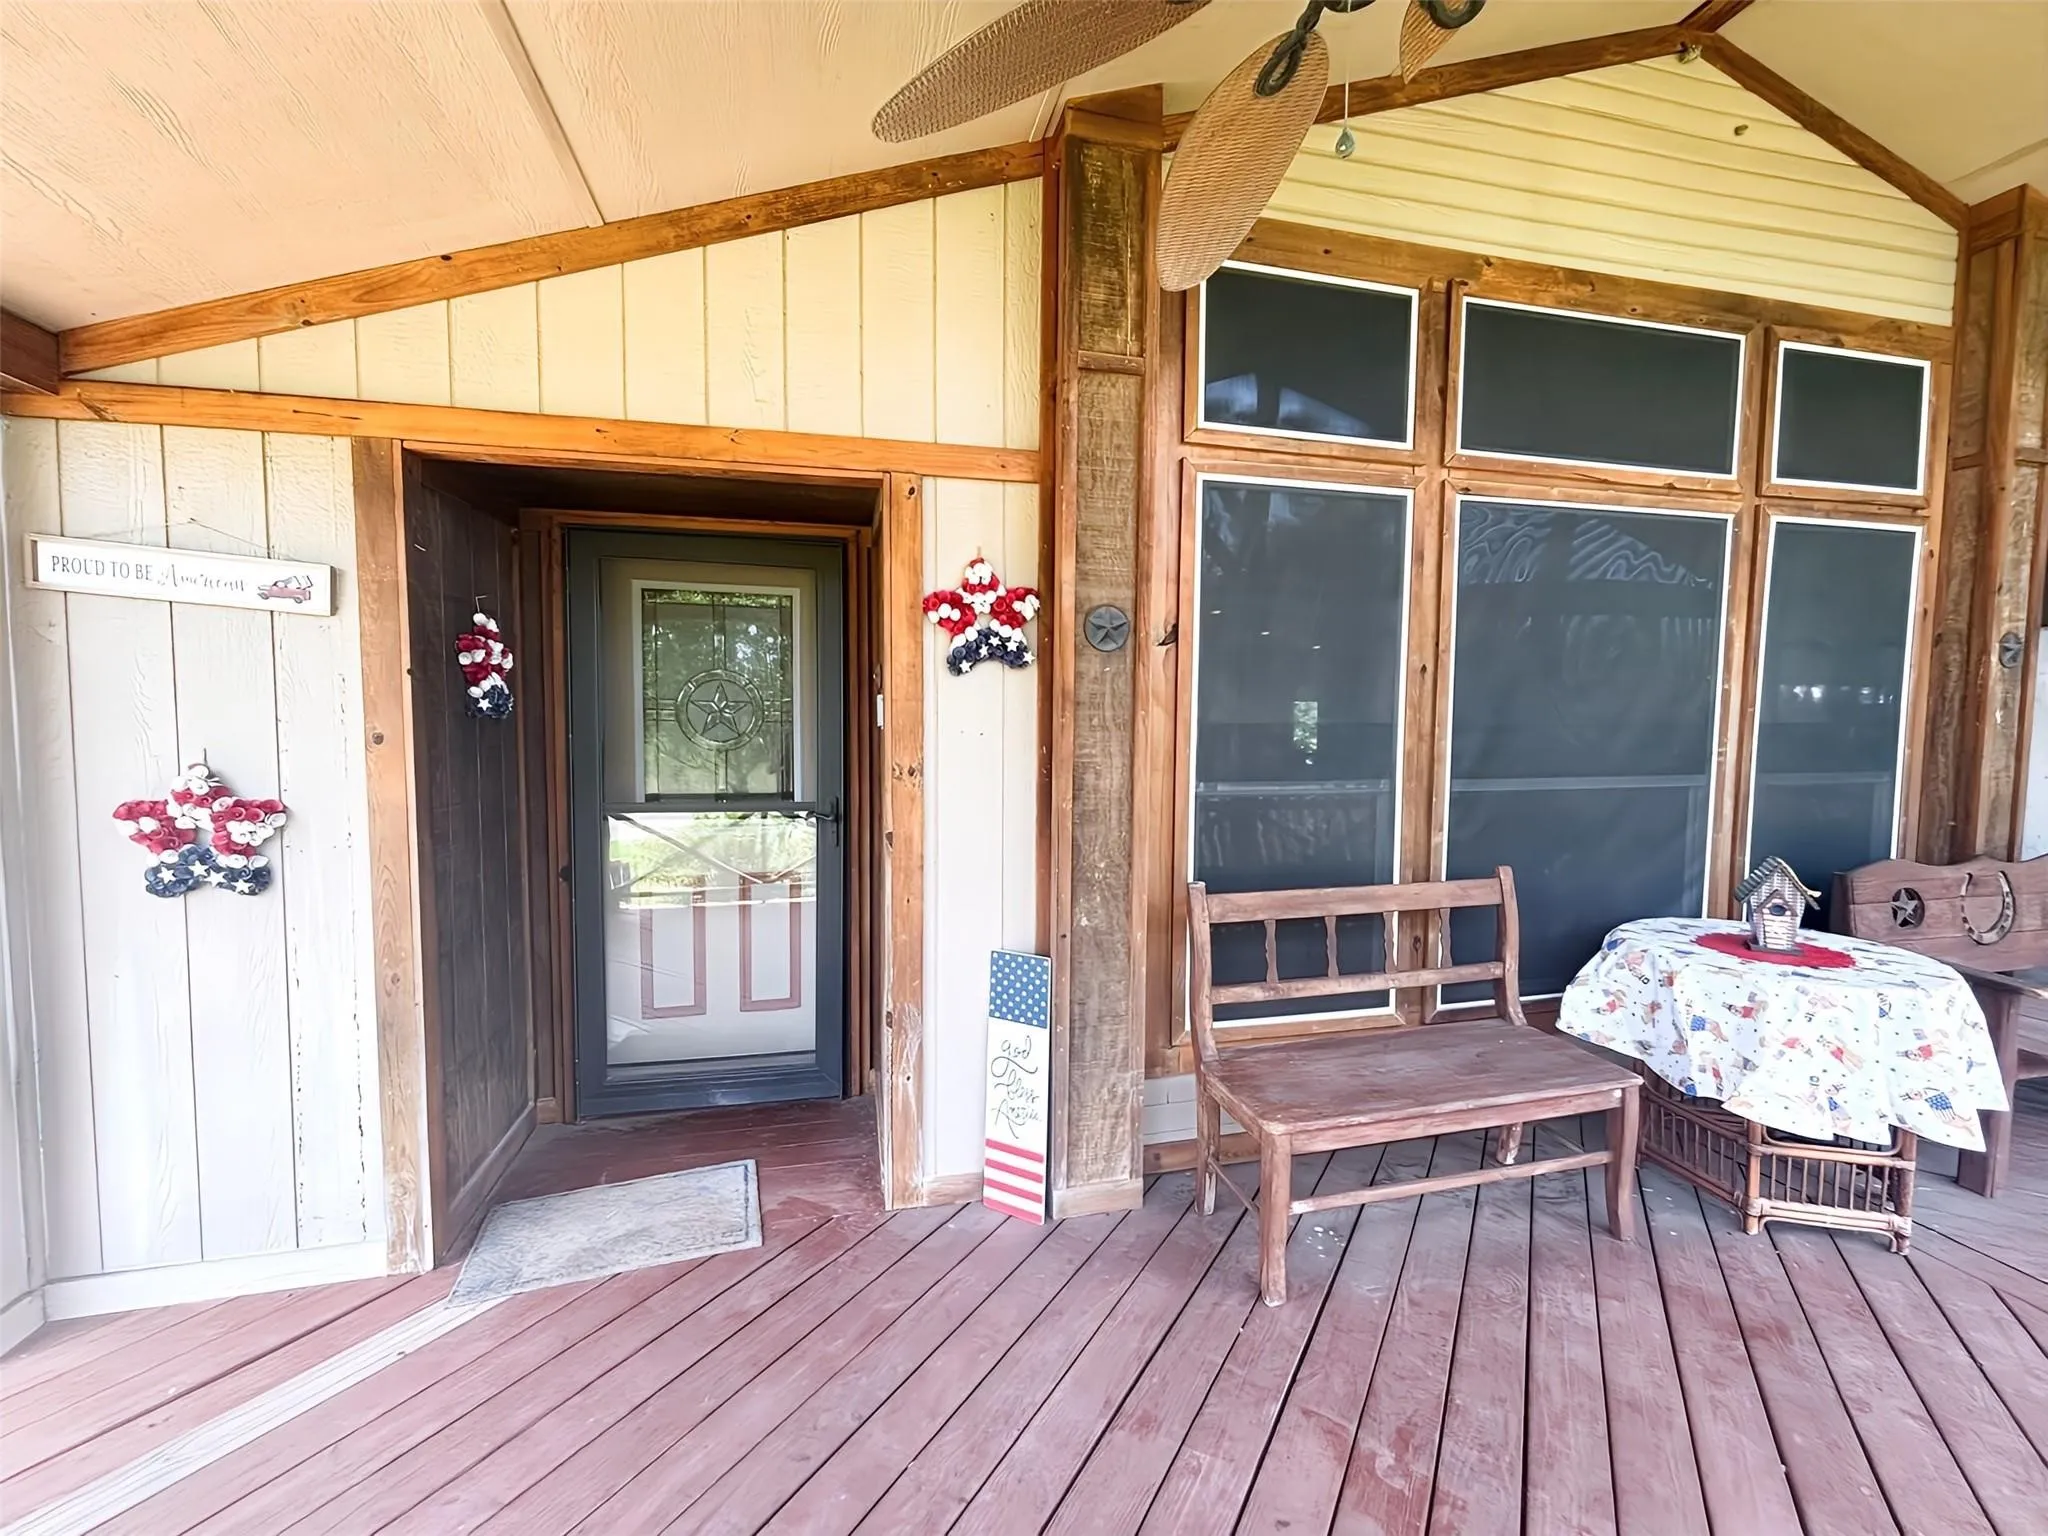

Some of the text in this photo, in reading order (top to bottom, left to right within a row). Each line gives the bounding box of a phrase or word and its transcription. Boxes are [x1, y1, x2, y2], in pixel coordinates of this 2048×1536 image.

[51, 555, 105, 576] PROUD
[110, 560, 130, 579] TO
[135, 563, 153, 581] BE
